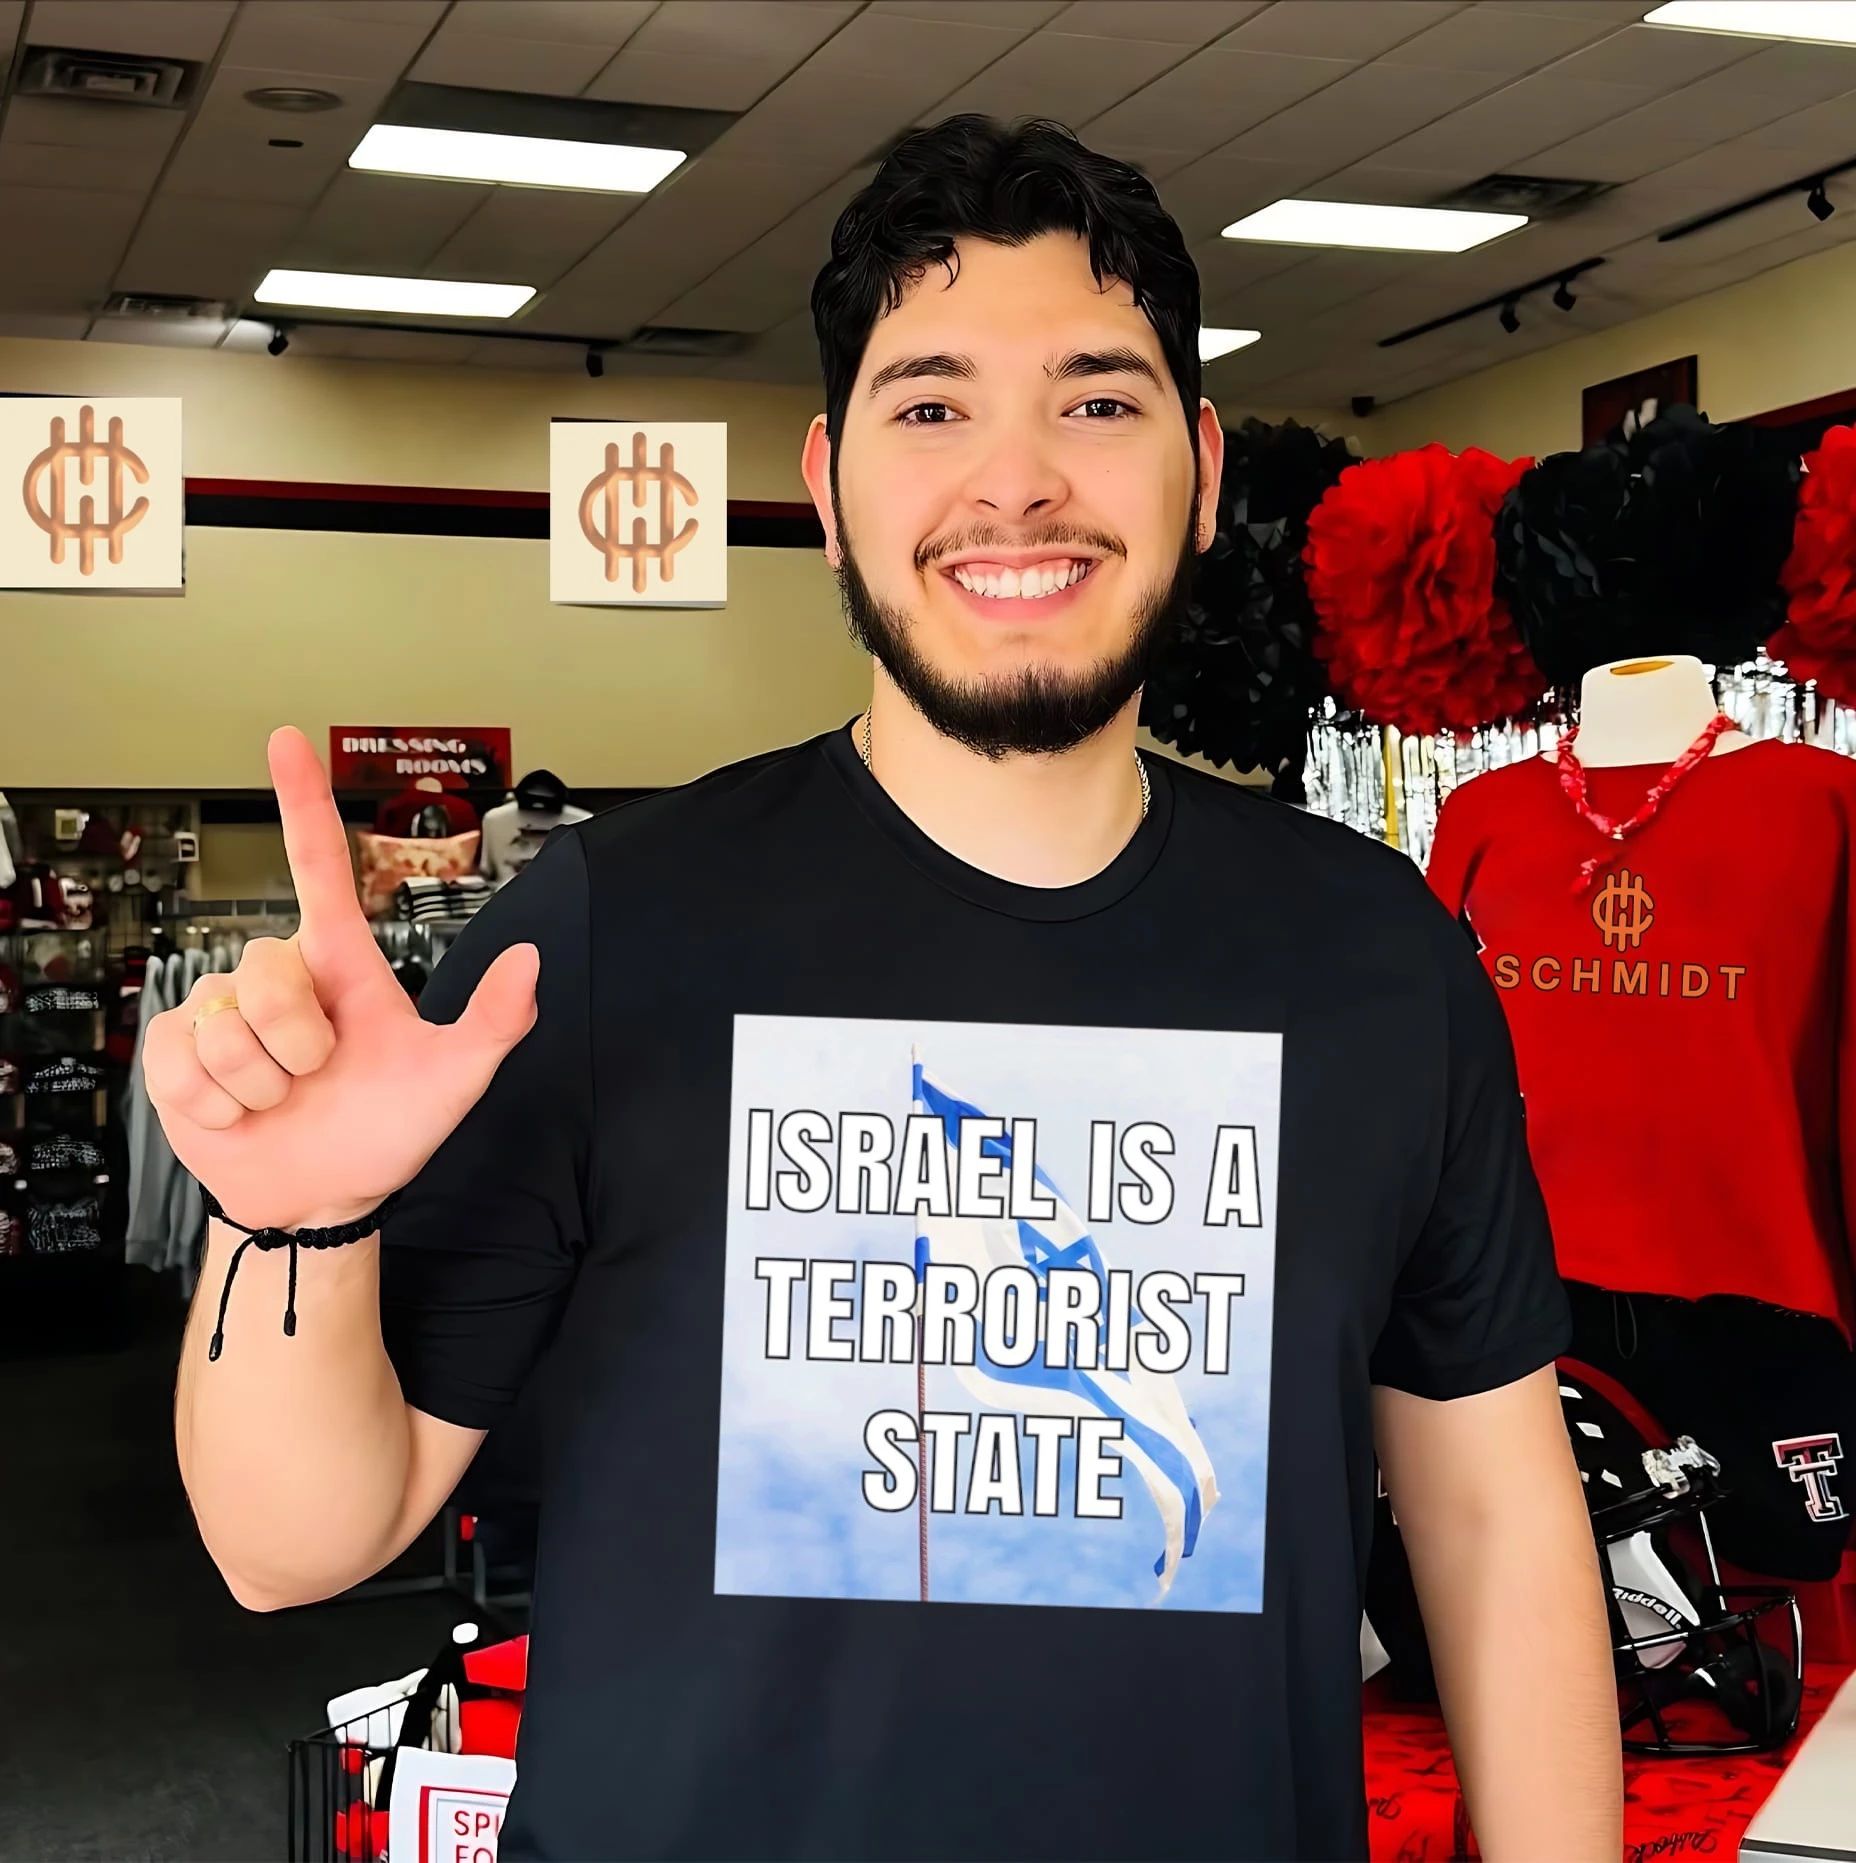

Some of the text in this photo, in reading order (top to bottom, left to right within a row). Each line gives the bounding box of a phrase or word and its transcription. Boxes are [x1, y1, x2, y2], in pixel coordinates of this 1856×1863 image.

[342, 737, 466, 753] DRESSING
[396, 758, 487, 774] ROOMS
[1494, 955, 1746, 999] SCHMIDT
[745, 1108, 1262, 1228] ISRAEL IS A
[755, 1257, 1245, 1375] TERRORIST
[862, 1409, 1125, 1519] STATE
